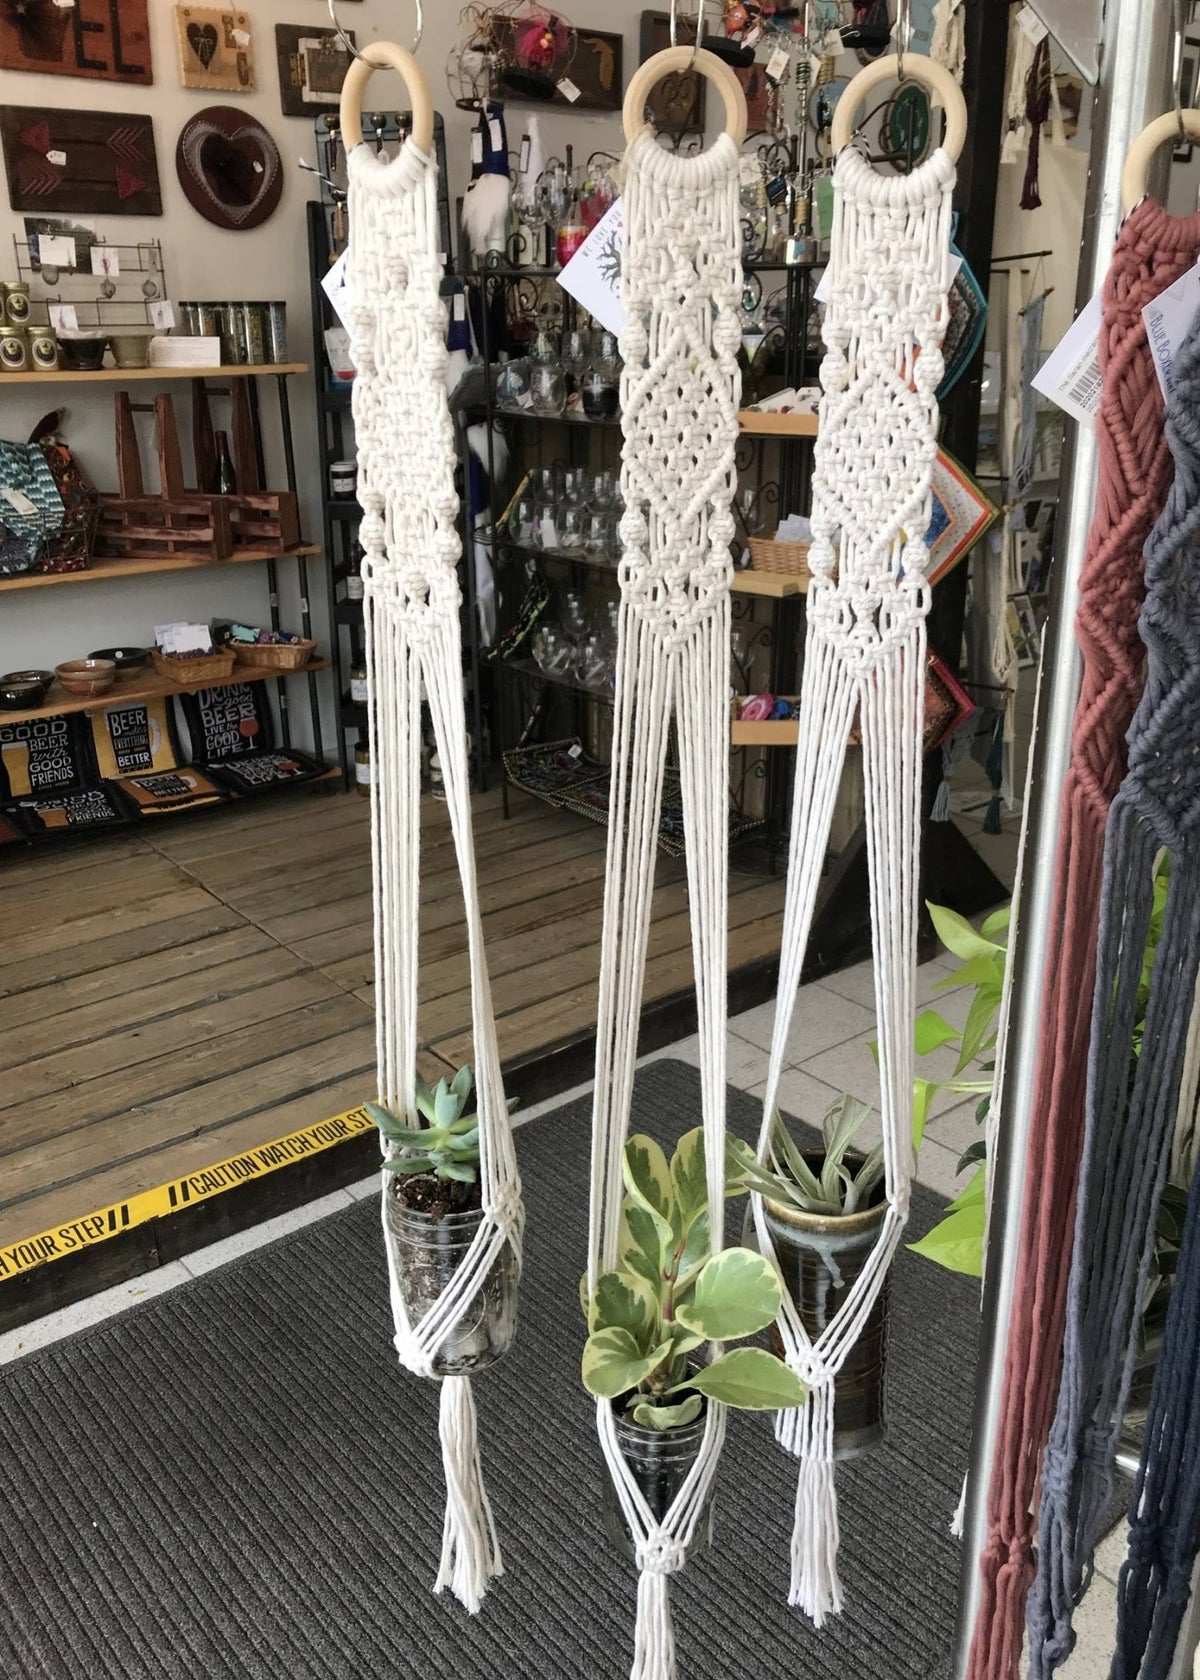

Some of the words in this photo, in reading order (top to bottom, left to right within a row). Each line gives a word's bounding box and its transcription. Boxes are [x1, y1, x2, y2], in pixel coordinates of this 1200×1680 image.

[592, 226, 608, 244] LOVE
[609, 210, 621, 224] YOU
[1150, 314, 1167, 343] BLUE
[110, 709, 146, 736] BEER
[201, 702, 257, 728] BEER
[0, 720, 67, 742] GOOD
[204, 724, 225, 736] LIVE
[206, 730, 239, 750] GOOD
[29, 733, 69, 752] BEER
[207, 742, 244, 759] LIFE
[29, 756, 72, 773] GOOD
[118, 751, 150, 767] BETTER
[31, 765, 74, 787] FRIENDS
[190, 1156, 261, 1195] CAUTION
[254, 1134, 315, 1168] WATCH
[307, 1118, 354, 1145] YOUR
[4, 1235, 62, 1269] YOUR
[58, 1215, 105, 1248] STEP
